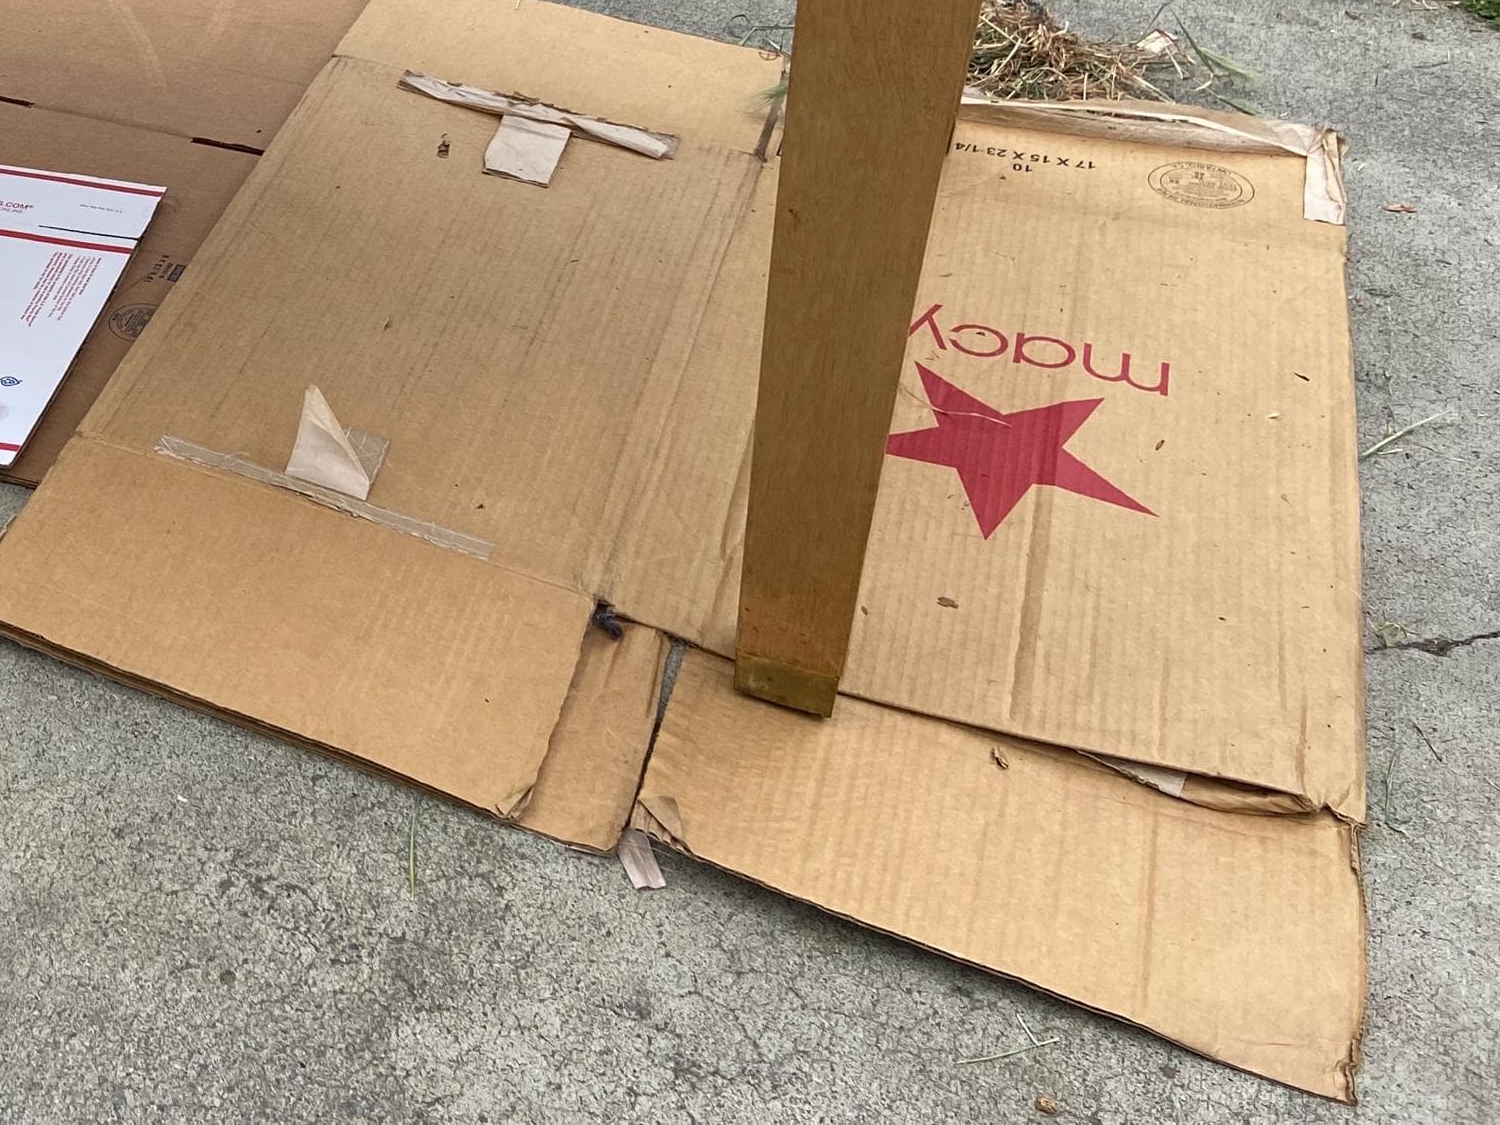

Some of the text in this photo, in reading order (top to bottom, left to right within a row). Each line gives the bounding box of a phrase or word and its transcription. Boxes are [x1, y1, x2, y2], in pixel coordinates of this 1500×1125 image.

[955, 141, 1097, 170] 17 X 15 X 23 1/4
[1012, 162, 1033, 173] 10
